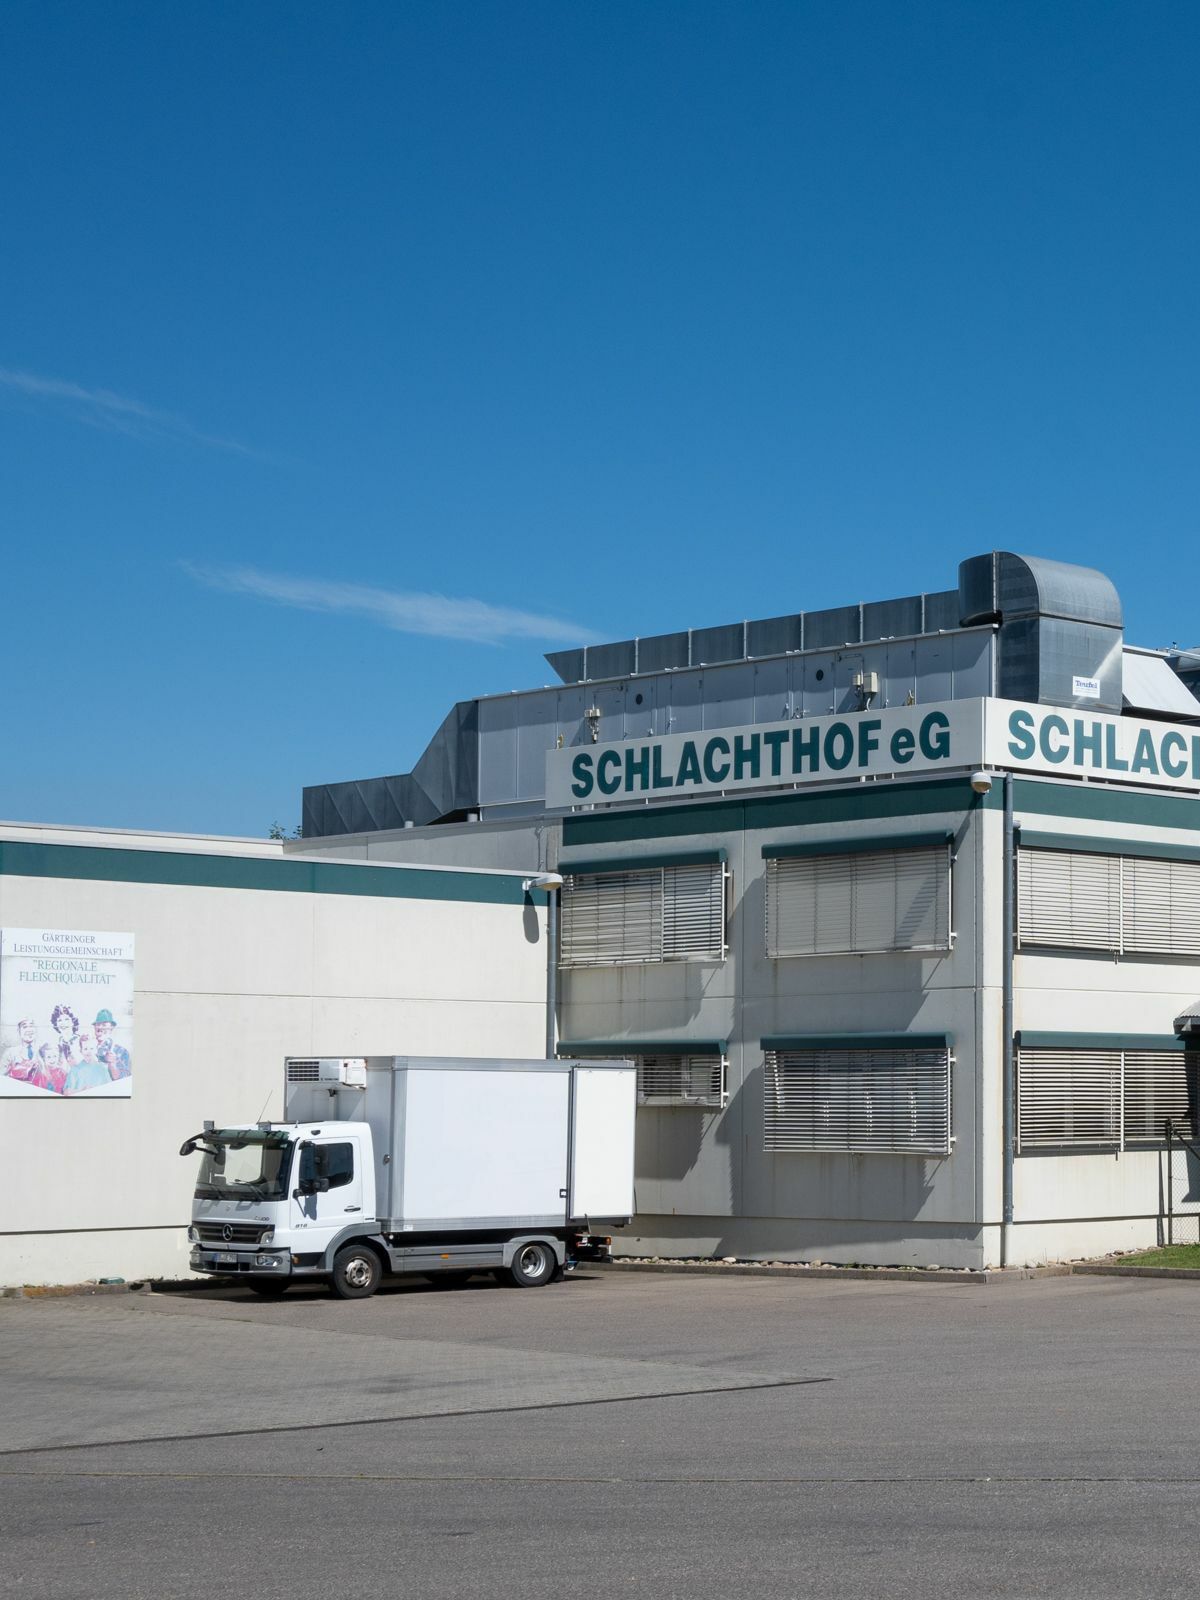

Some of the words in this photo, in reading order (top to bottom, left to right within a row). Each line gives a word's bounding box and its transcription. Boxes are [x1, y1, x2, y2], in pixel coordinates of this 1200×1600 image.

[571, 719, 882, 798] SCHLACHTHOF
[890, 710, 951, 764] eG
[14, 943, 122, 956] LEISTUNGSGEMEINSCHAFT
